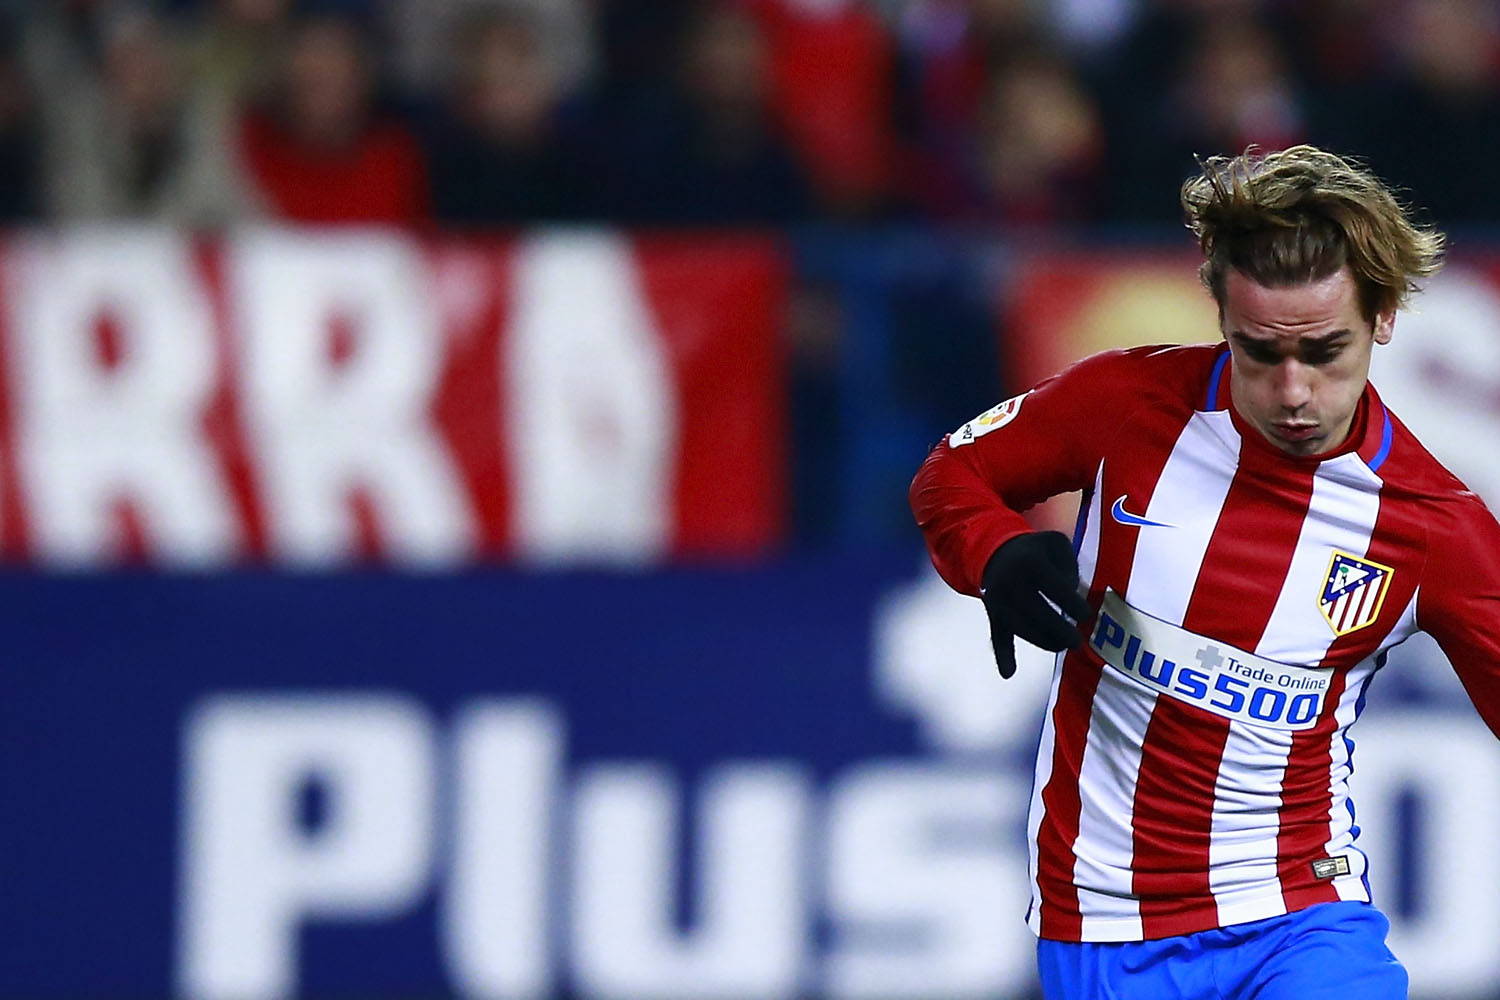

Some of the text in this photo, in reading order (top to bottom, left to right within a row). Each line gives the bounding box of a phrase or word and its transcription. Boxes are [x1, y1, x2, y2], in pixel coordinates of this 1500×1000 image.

[1093, 610, 1321, 726] Plus500
[1227, 656, 1328, 691] Trade Online
